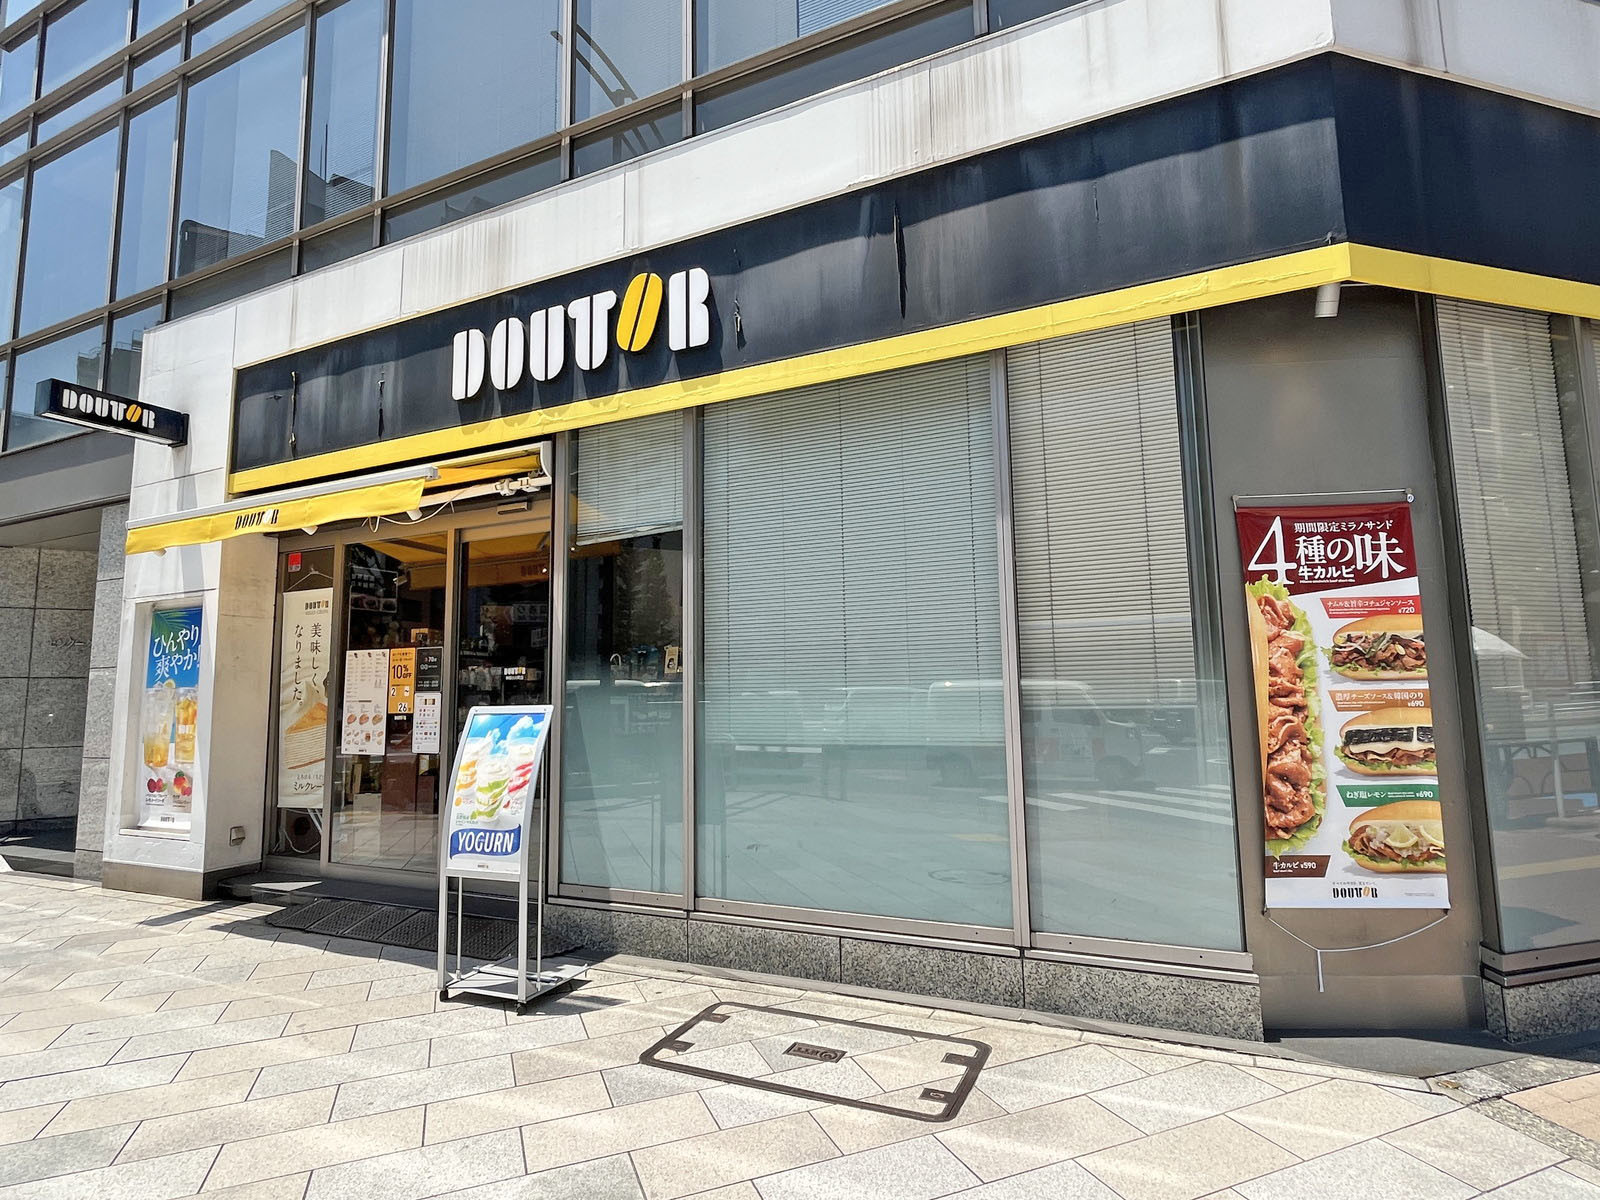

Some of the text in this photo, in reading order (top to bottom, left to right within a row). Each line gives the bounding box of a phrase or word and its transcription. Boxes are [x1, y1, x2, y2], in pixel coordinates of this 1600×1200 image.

[452, 267, 709, 400] DOUTOR
[62, 388, 156, 429] DOUTOR
[1294, 520, 1393, 533] 期間限定ミラノサンド
[1298, 564, 1356, 580] 牛カルビ
[153, 624, 199, 657] ひんやり
[294, 781, 325, 791] ミルクレー
[458, 831, 514, 853] YOGURN
[1332, 886, 1378, 898] DOUTOR
